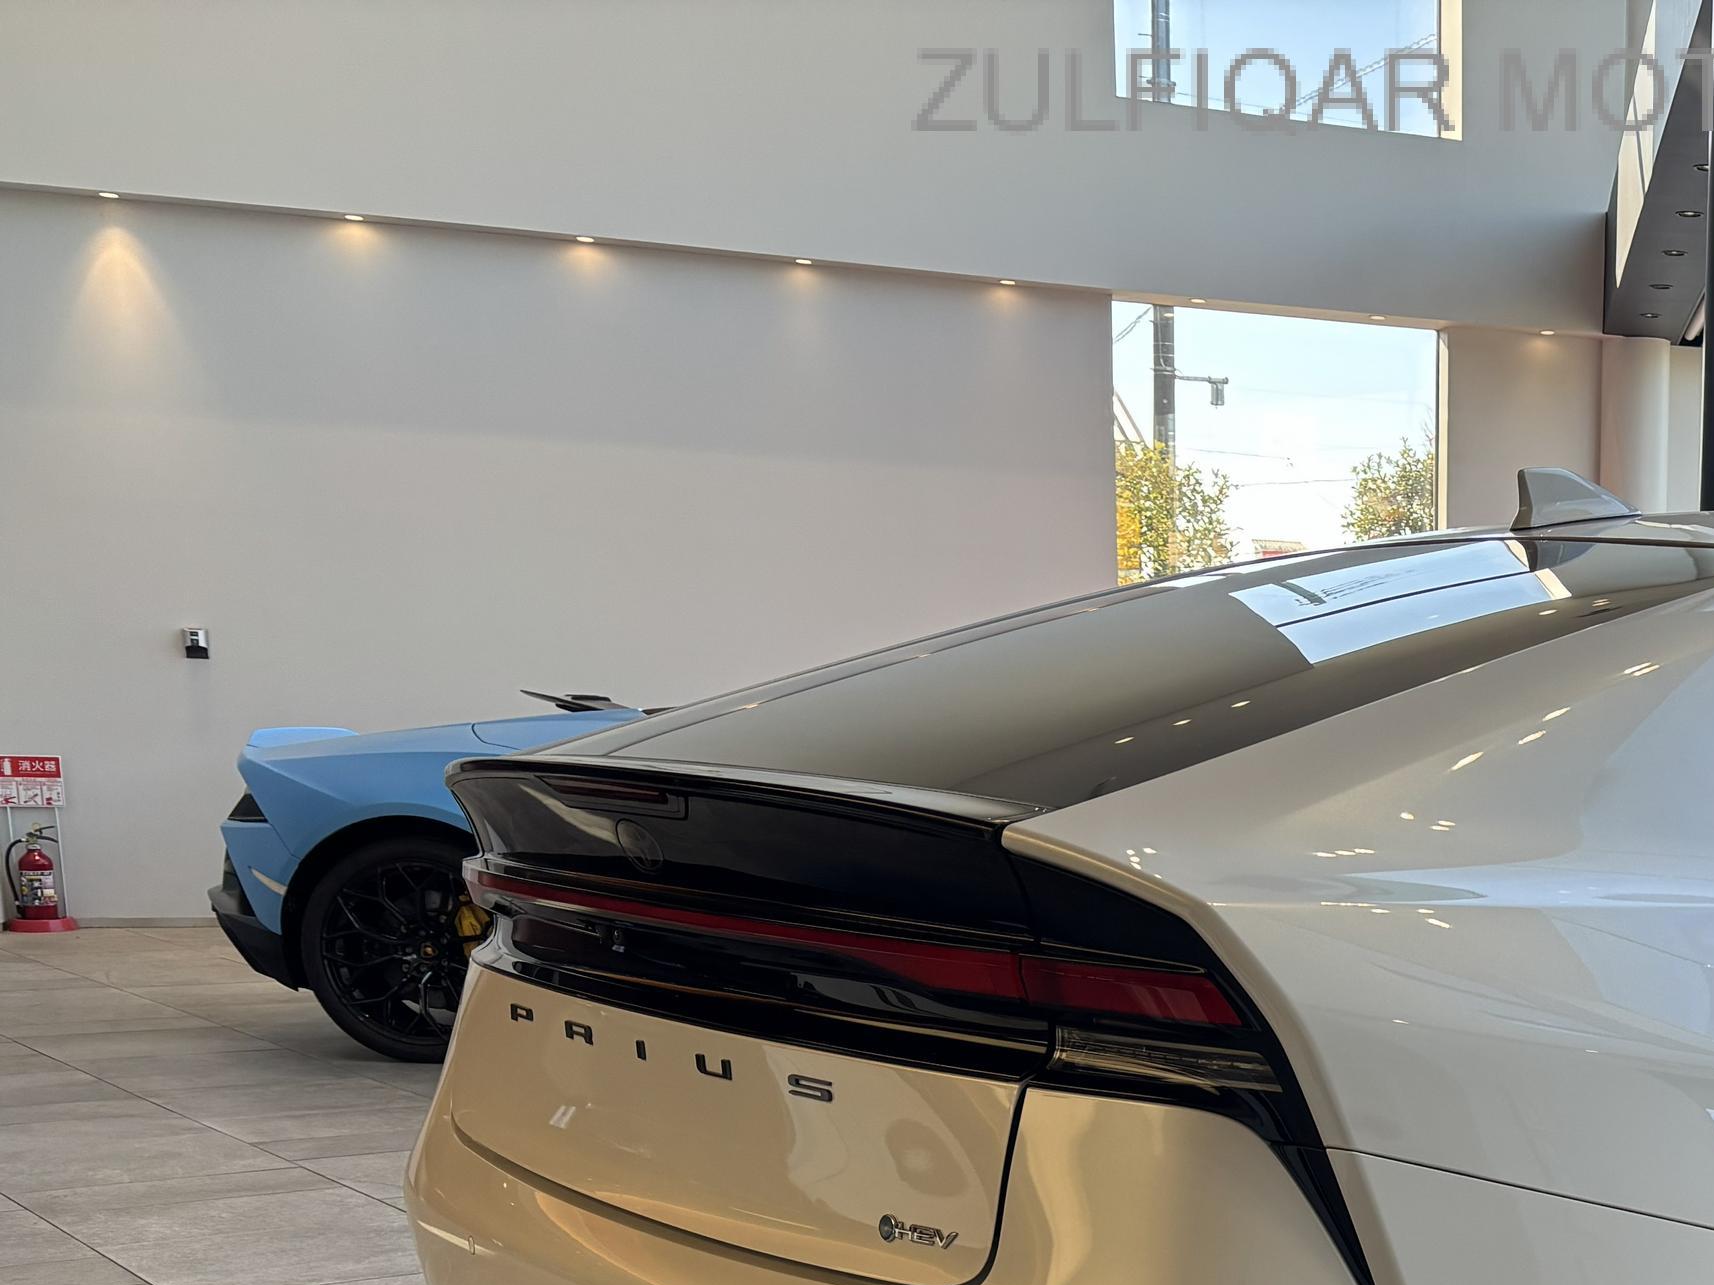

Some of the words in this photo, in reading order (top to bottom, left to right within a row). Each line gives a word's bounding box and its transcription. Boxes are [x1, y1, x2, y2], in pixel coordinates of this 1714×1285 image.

[18, 760, 57, 772] 消火器
[510, 1002, 833, 1102] PRIUS
[894, 1221, 959, 1249] HEV
